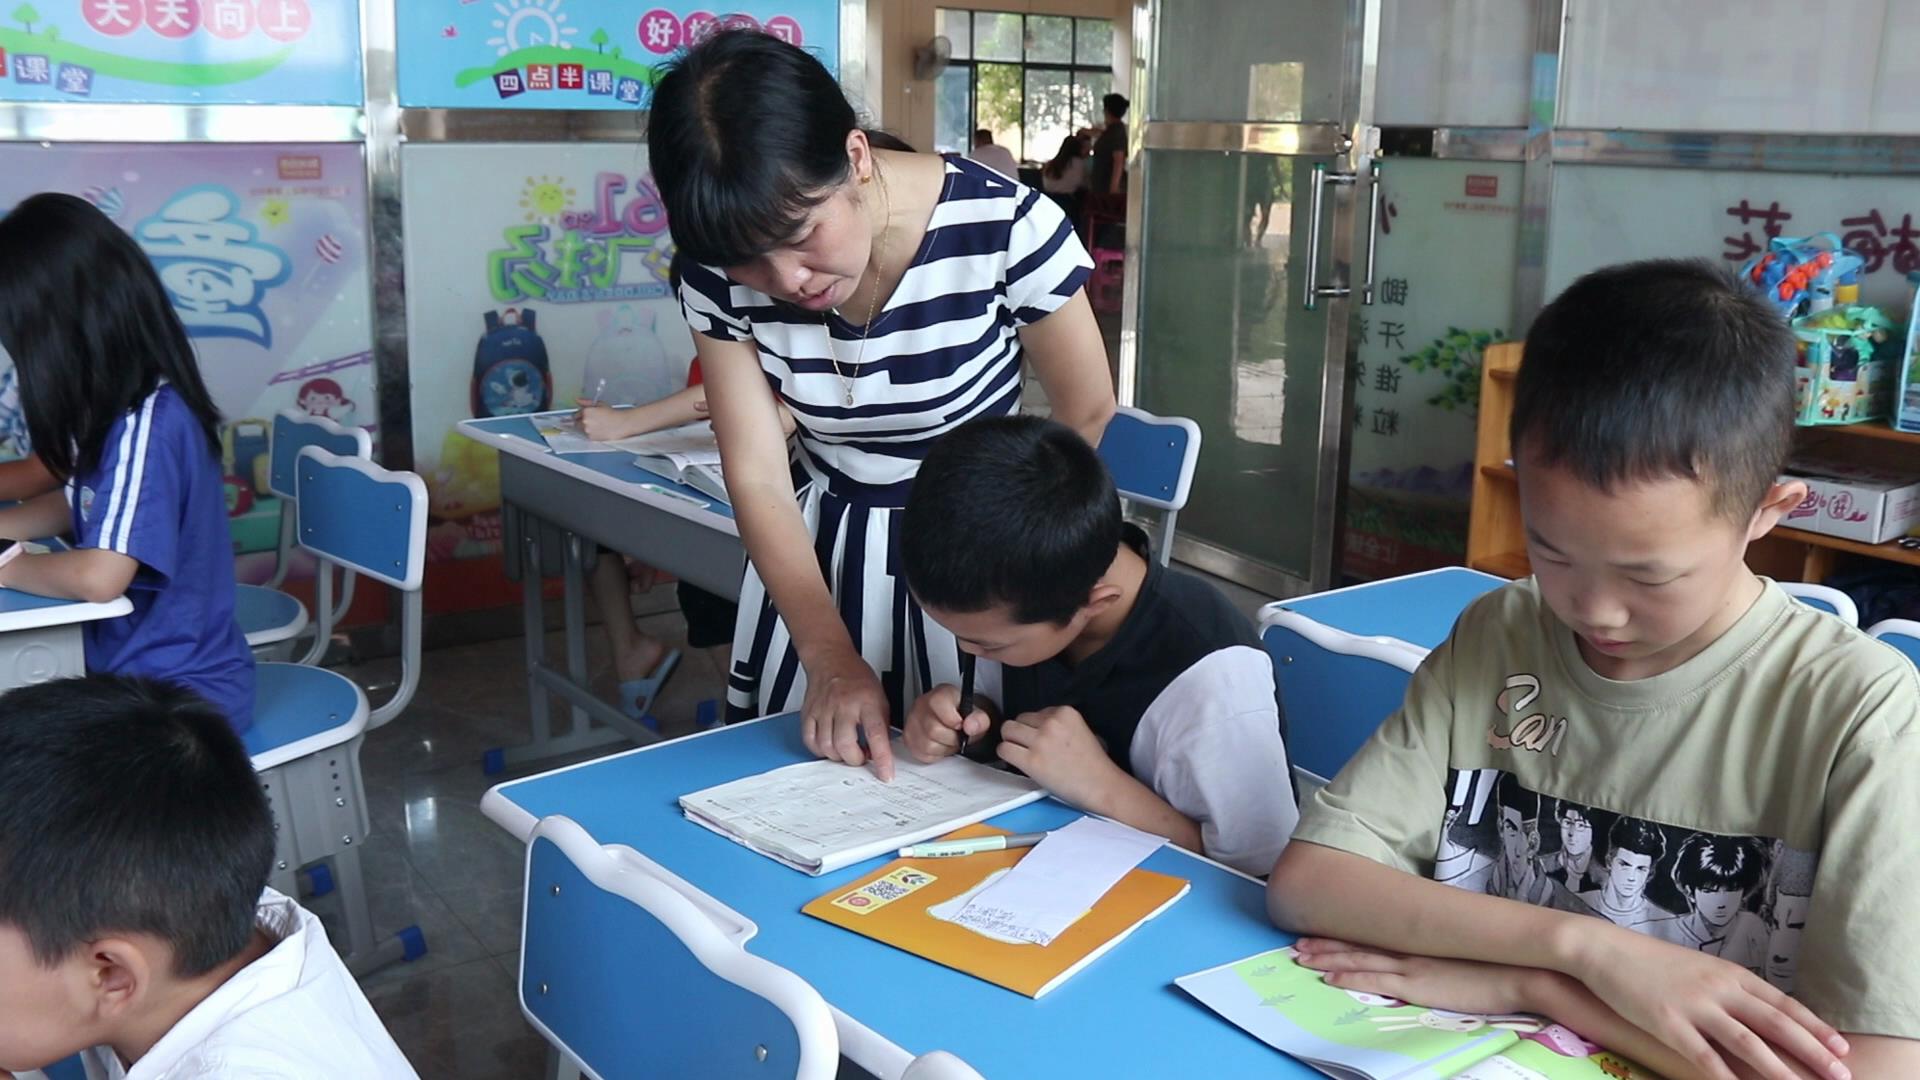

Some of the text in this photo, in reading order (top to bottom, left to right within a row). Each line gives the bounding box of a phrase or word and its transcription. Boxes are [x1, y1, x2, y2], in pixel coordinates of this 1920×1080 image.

[95, 0, 304, 33] 天天向上
[0, 56, 89, 93] 课堂
[500, 66, 642, 102] 四点半课堂
